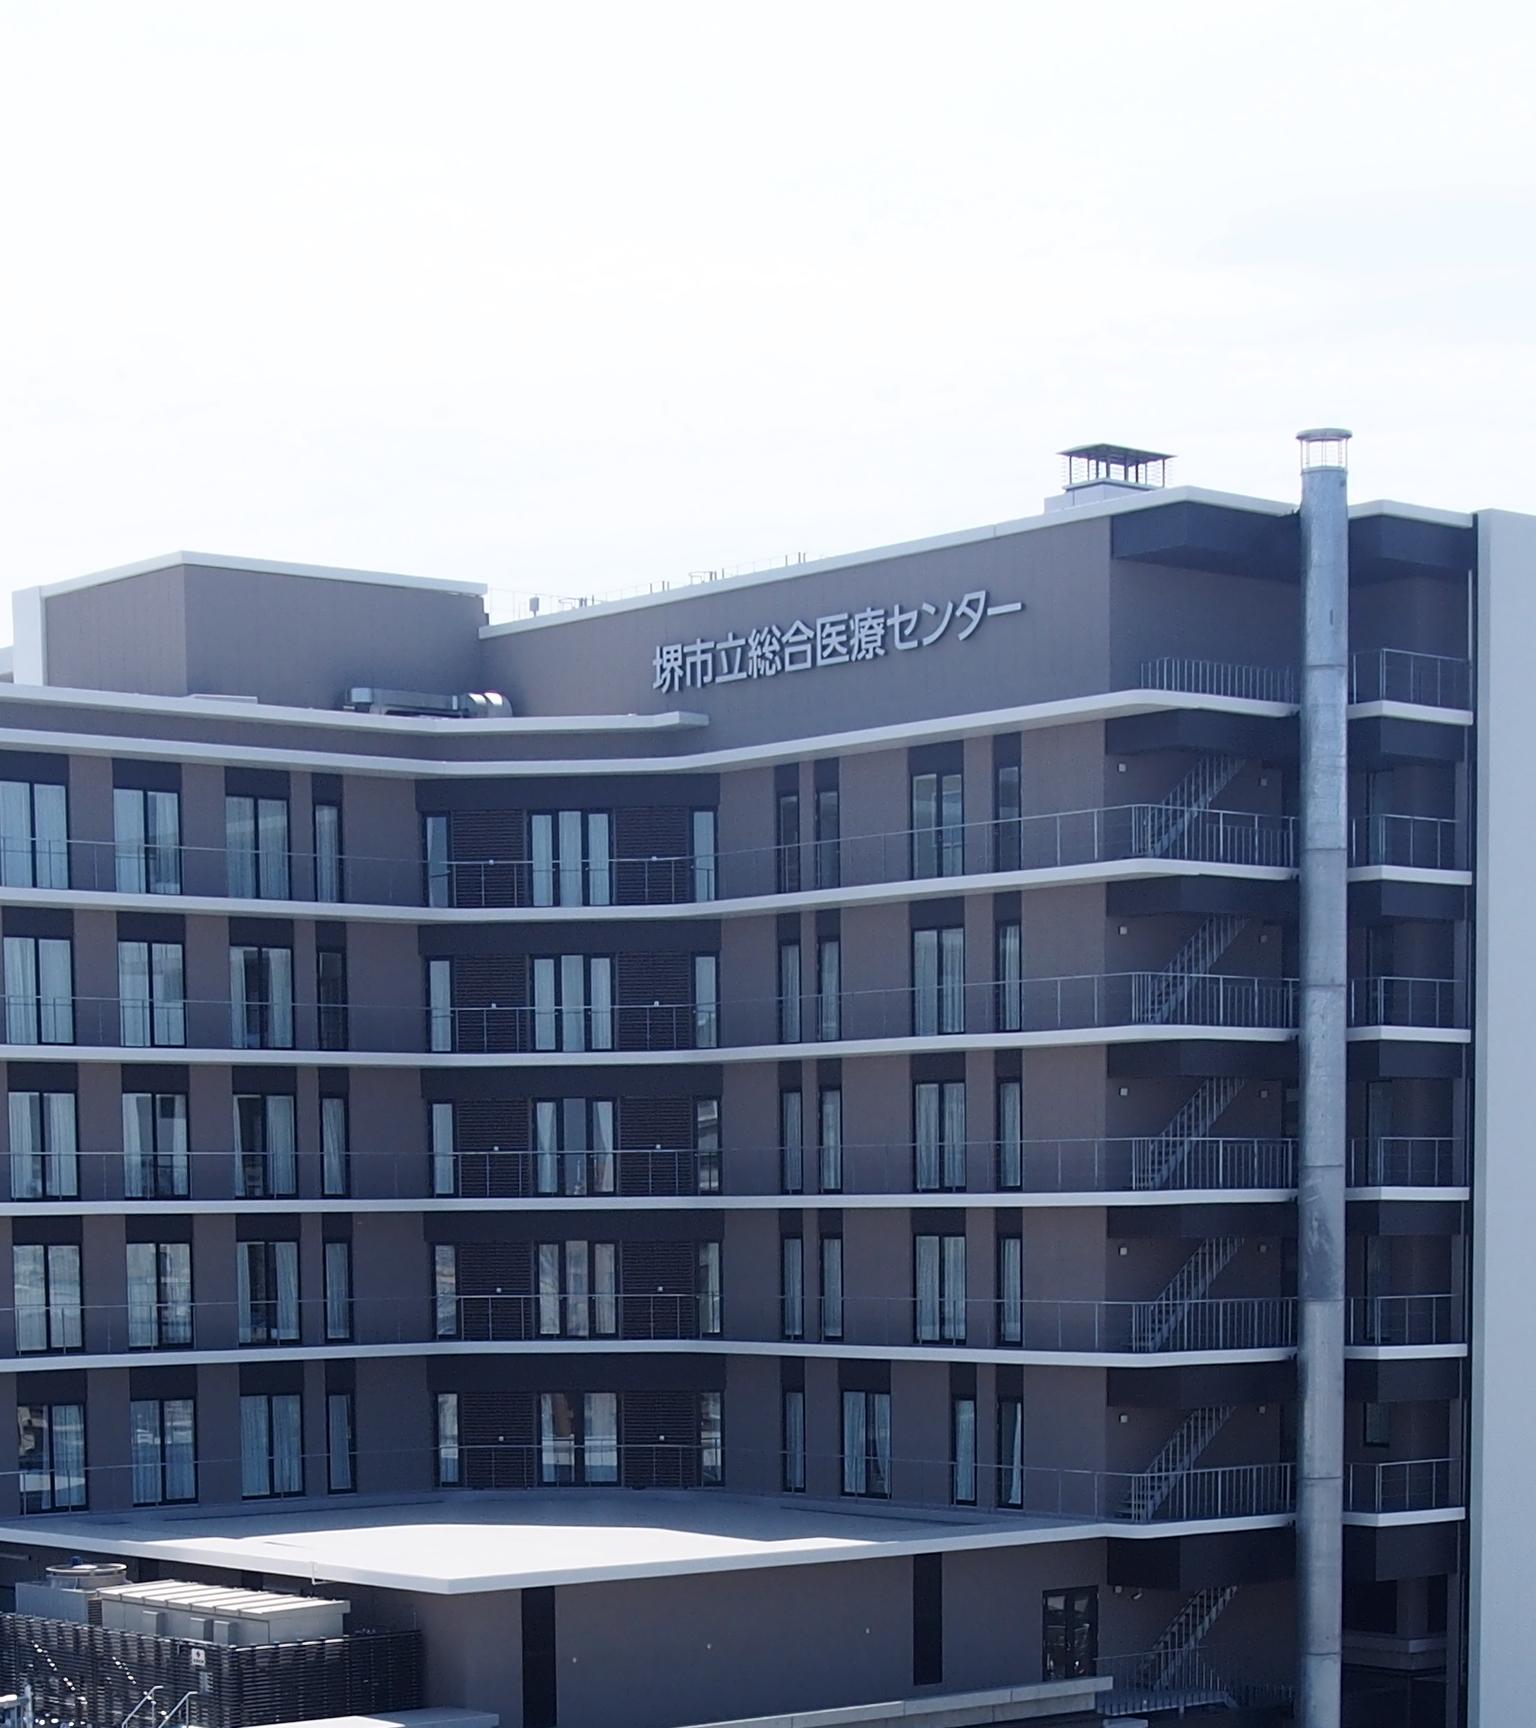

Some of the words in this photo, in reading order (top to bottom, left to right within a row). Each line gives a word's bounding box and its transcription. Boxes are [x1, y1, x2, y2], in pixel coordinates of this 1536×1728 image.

[652, 590, 1025, 693] 堺市立総合医療センター
